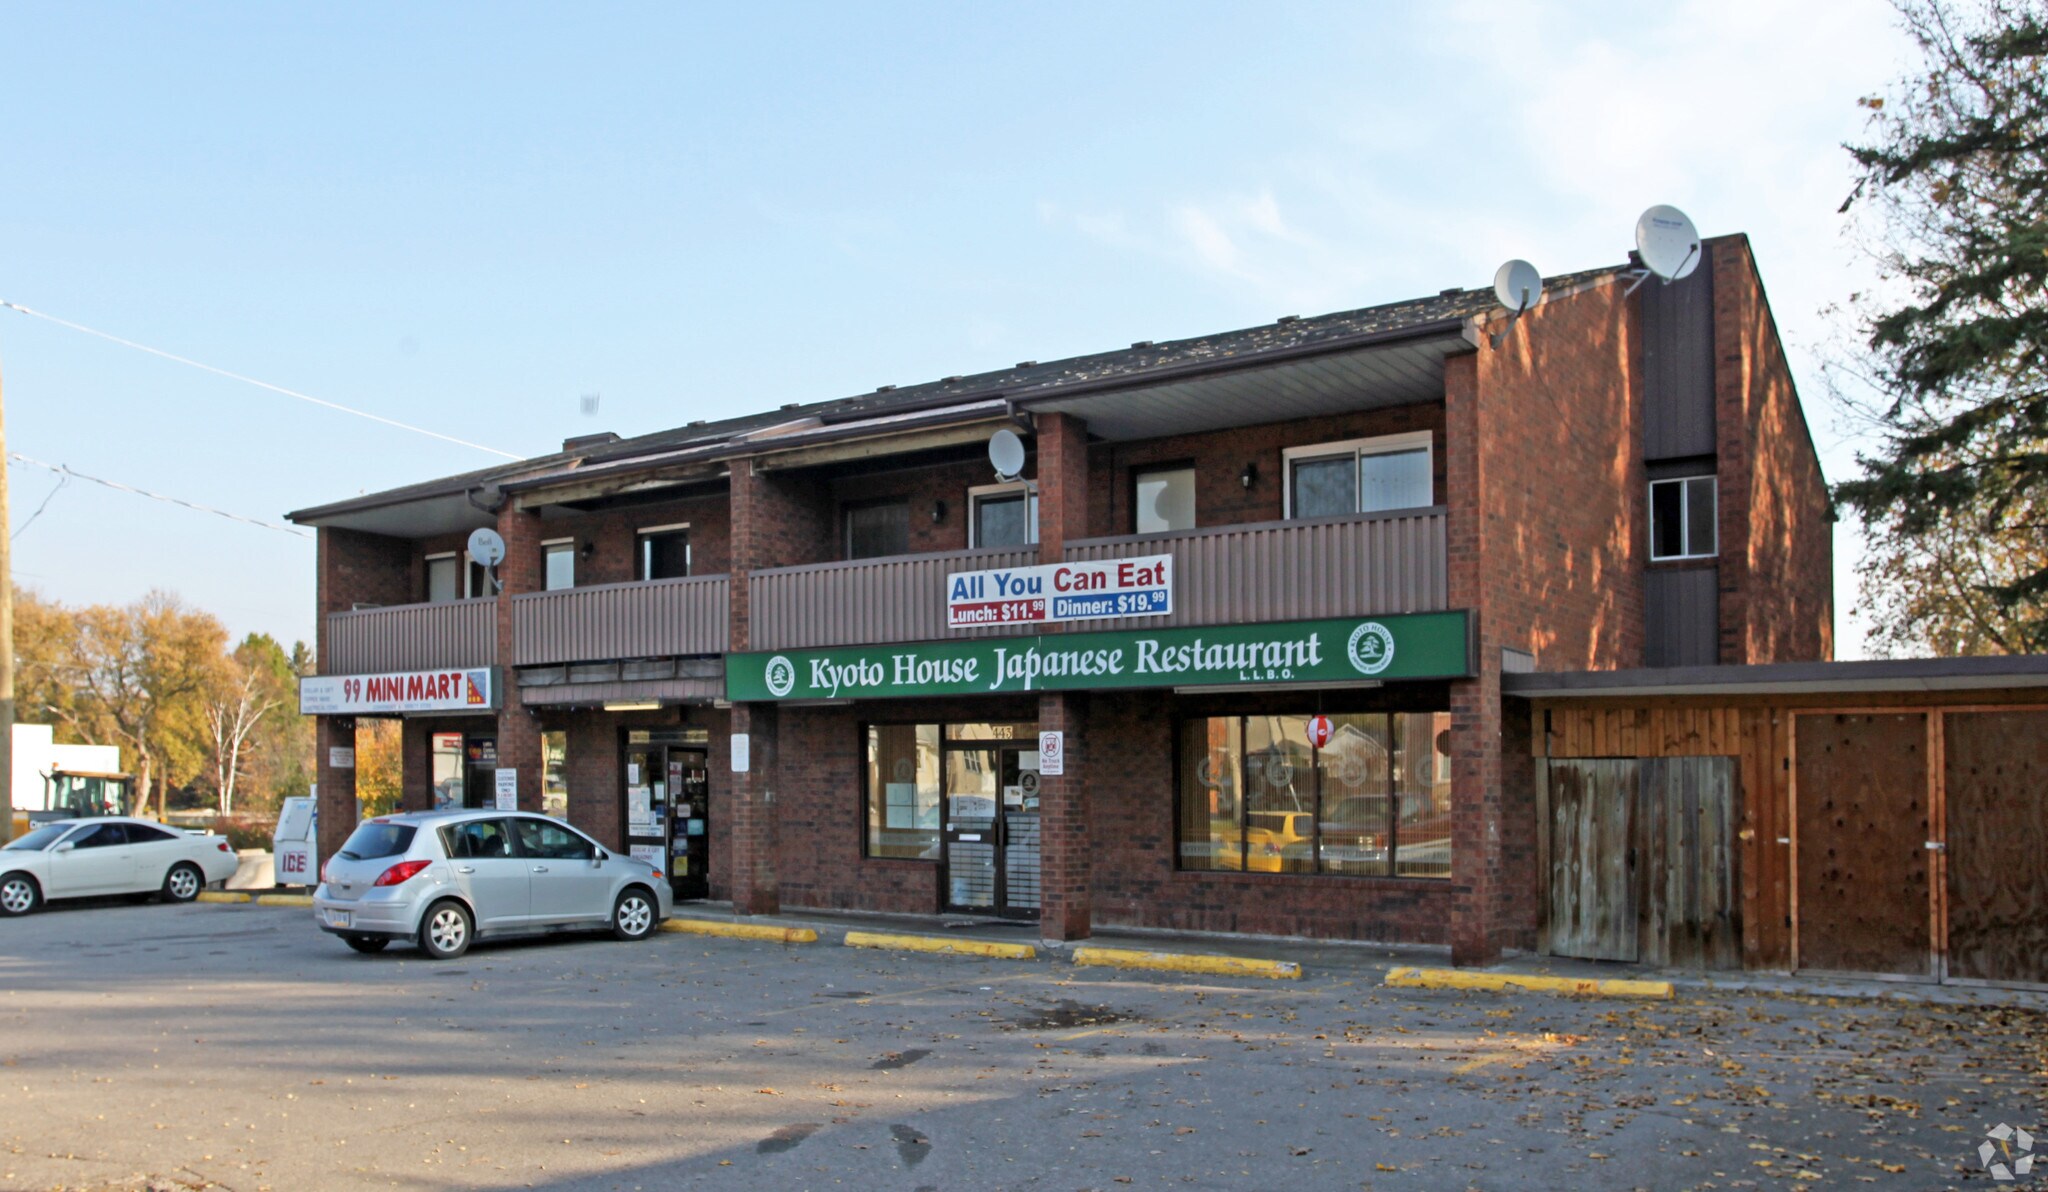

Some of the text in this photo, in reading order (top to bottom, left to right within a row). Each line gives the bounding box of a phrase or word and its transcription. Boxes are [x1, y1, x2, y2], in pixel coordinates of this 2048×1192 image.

[478, 537, 493, 546] Bell
[952, 561, 1165, 600] All You Can Eat
[950, 600, 1045, 624] Lunch: $11.99
[1057, 590, 1165, 617] Dinner: $19.99
[808, 632, 1323, 698] Kyoto House Japanese Restaurant
[343, 672, 462, 703] 99 MINI MART
[992, 727, 1012, 739] 443
[282, 853, 306, 872] ICE
